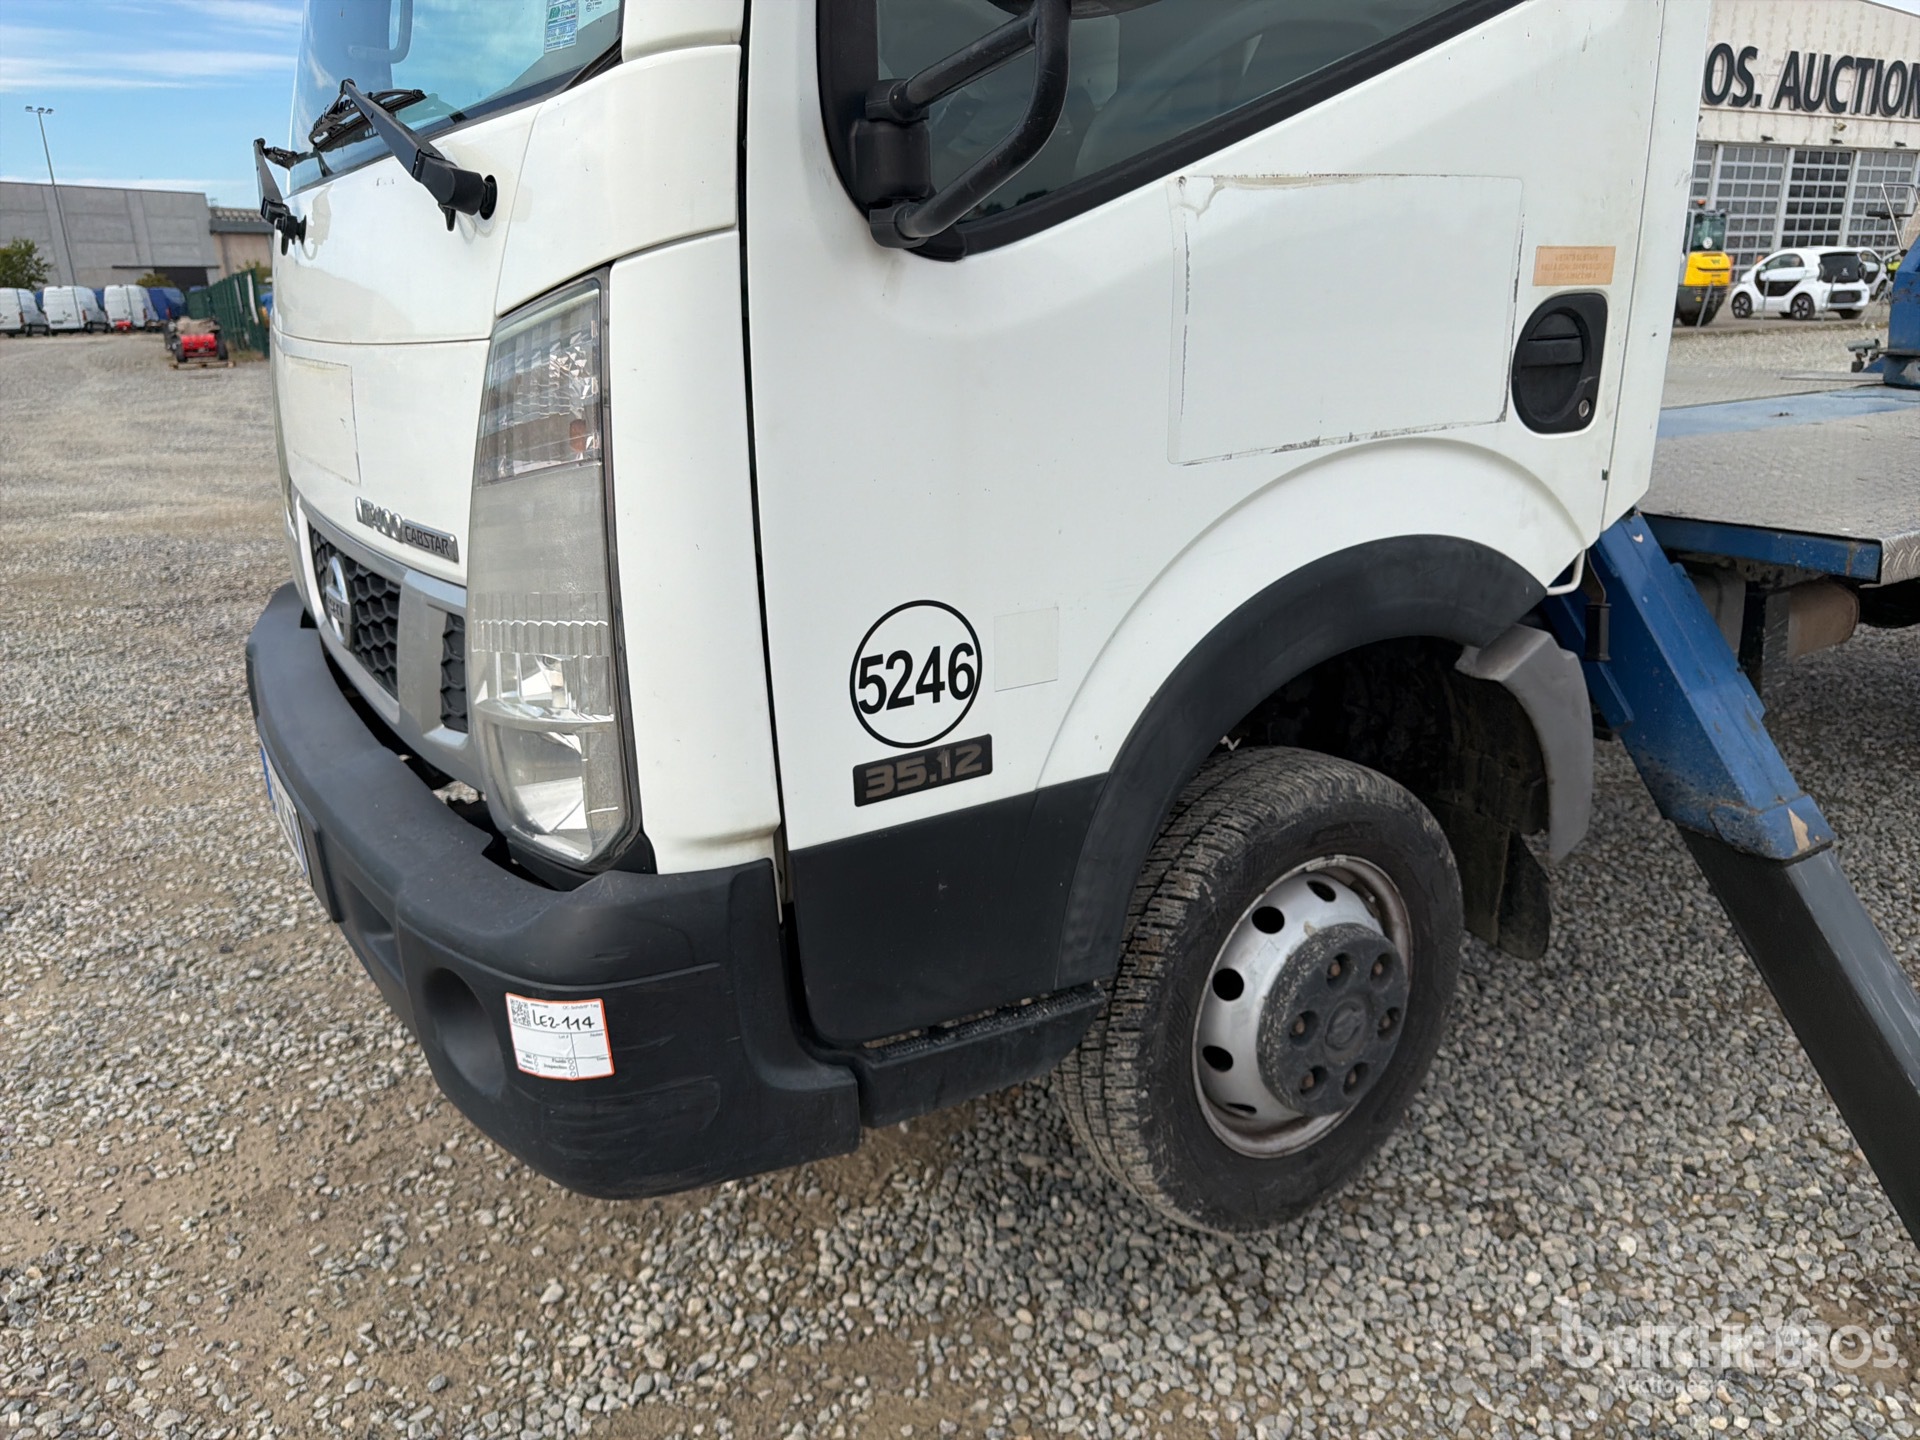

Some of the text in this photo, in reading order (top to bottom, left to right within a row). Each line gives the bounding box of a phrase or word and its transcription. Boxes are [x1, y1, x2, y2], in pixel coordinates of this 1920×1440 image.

[404, 525, 450, 557] CABSTAR
[858, 642, 976, 715] 5246
[865, 743, 983, 799] 35.12
